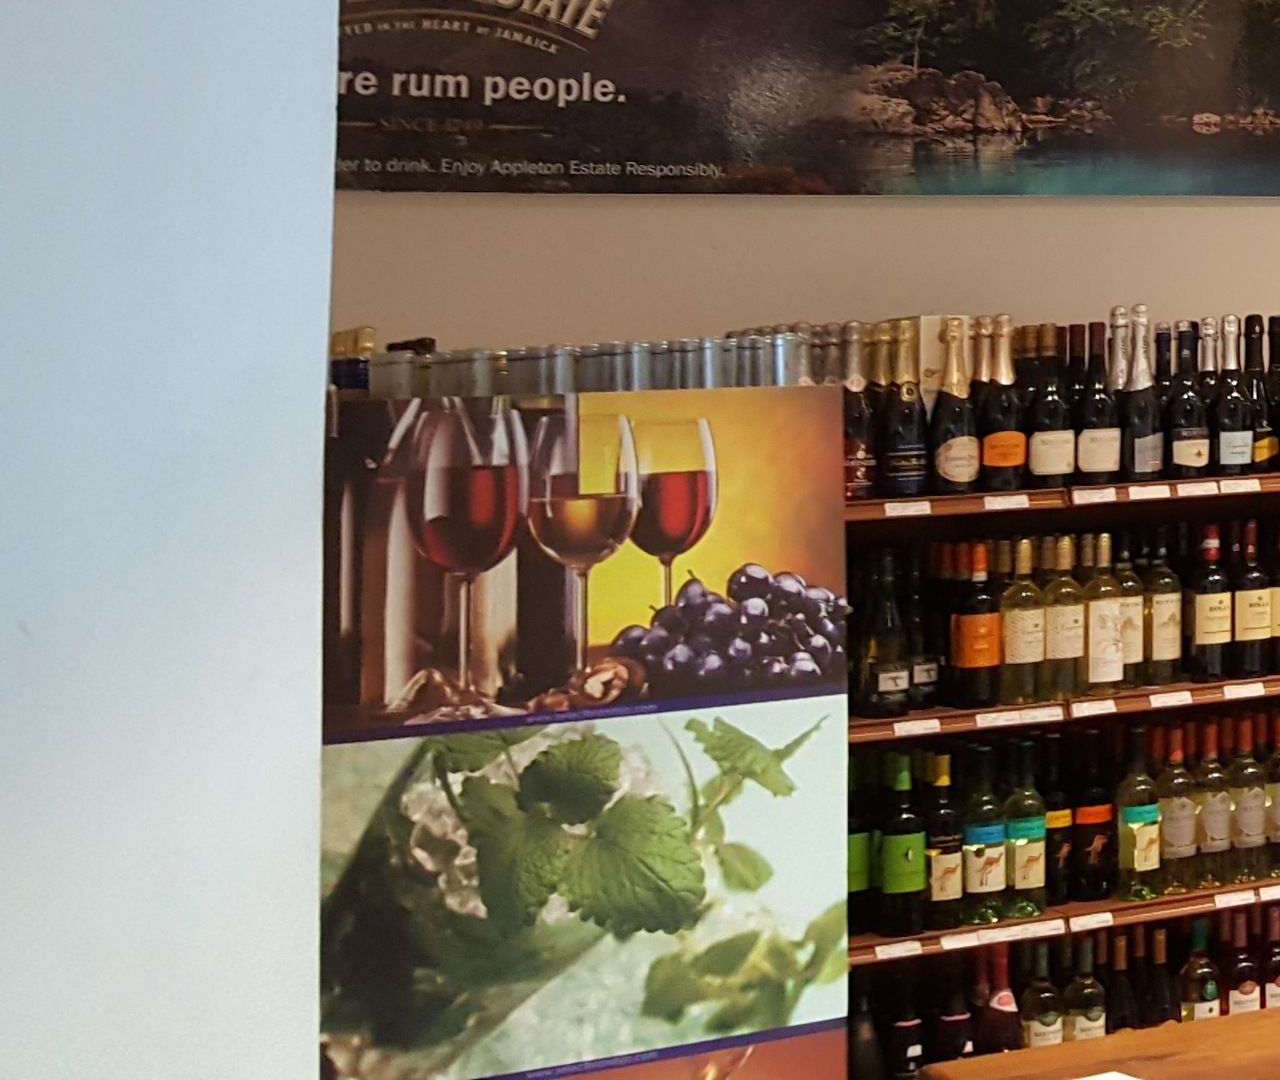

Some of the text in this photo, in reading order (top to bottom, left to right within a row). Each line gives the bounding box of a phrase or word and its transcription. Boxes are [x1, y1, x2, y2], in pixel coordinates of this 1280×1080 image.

[421, 19, 471, 35] HEART
[495, 27, 560, 55] JAMAICA
[391, 71, 470, 99] rum
[483, 70, 627, 108] people.
[364, 157, 382, 172] to
[440, 158, 484, 177] Enjoy
[491, 159, 564, 177] Appleton
[569, 160, 622, 176] Estate
[625, 161, 726, 179] Responsibly.
